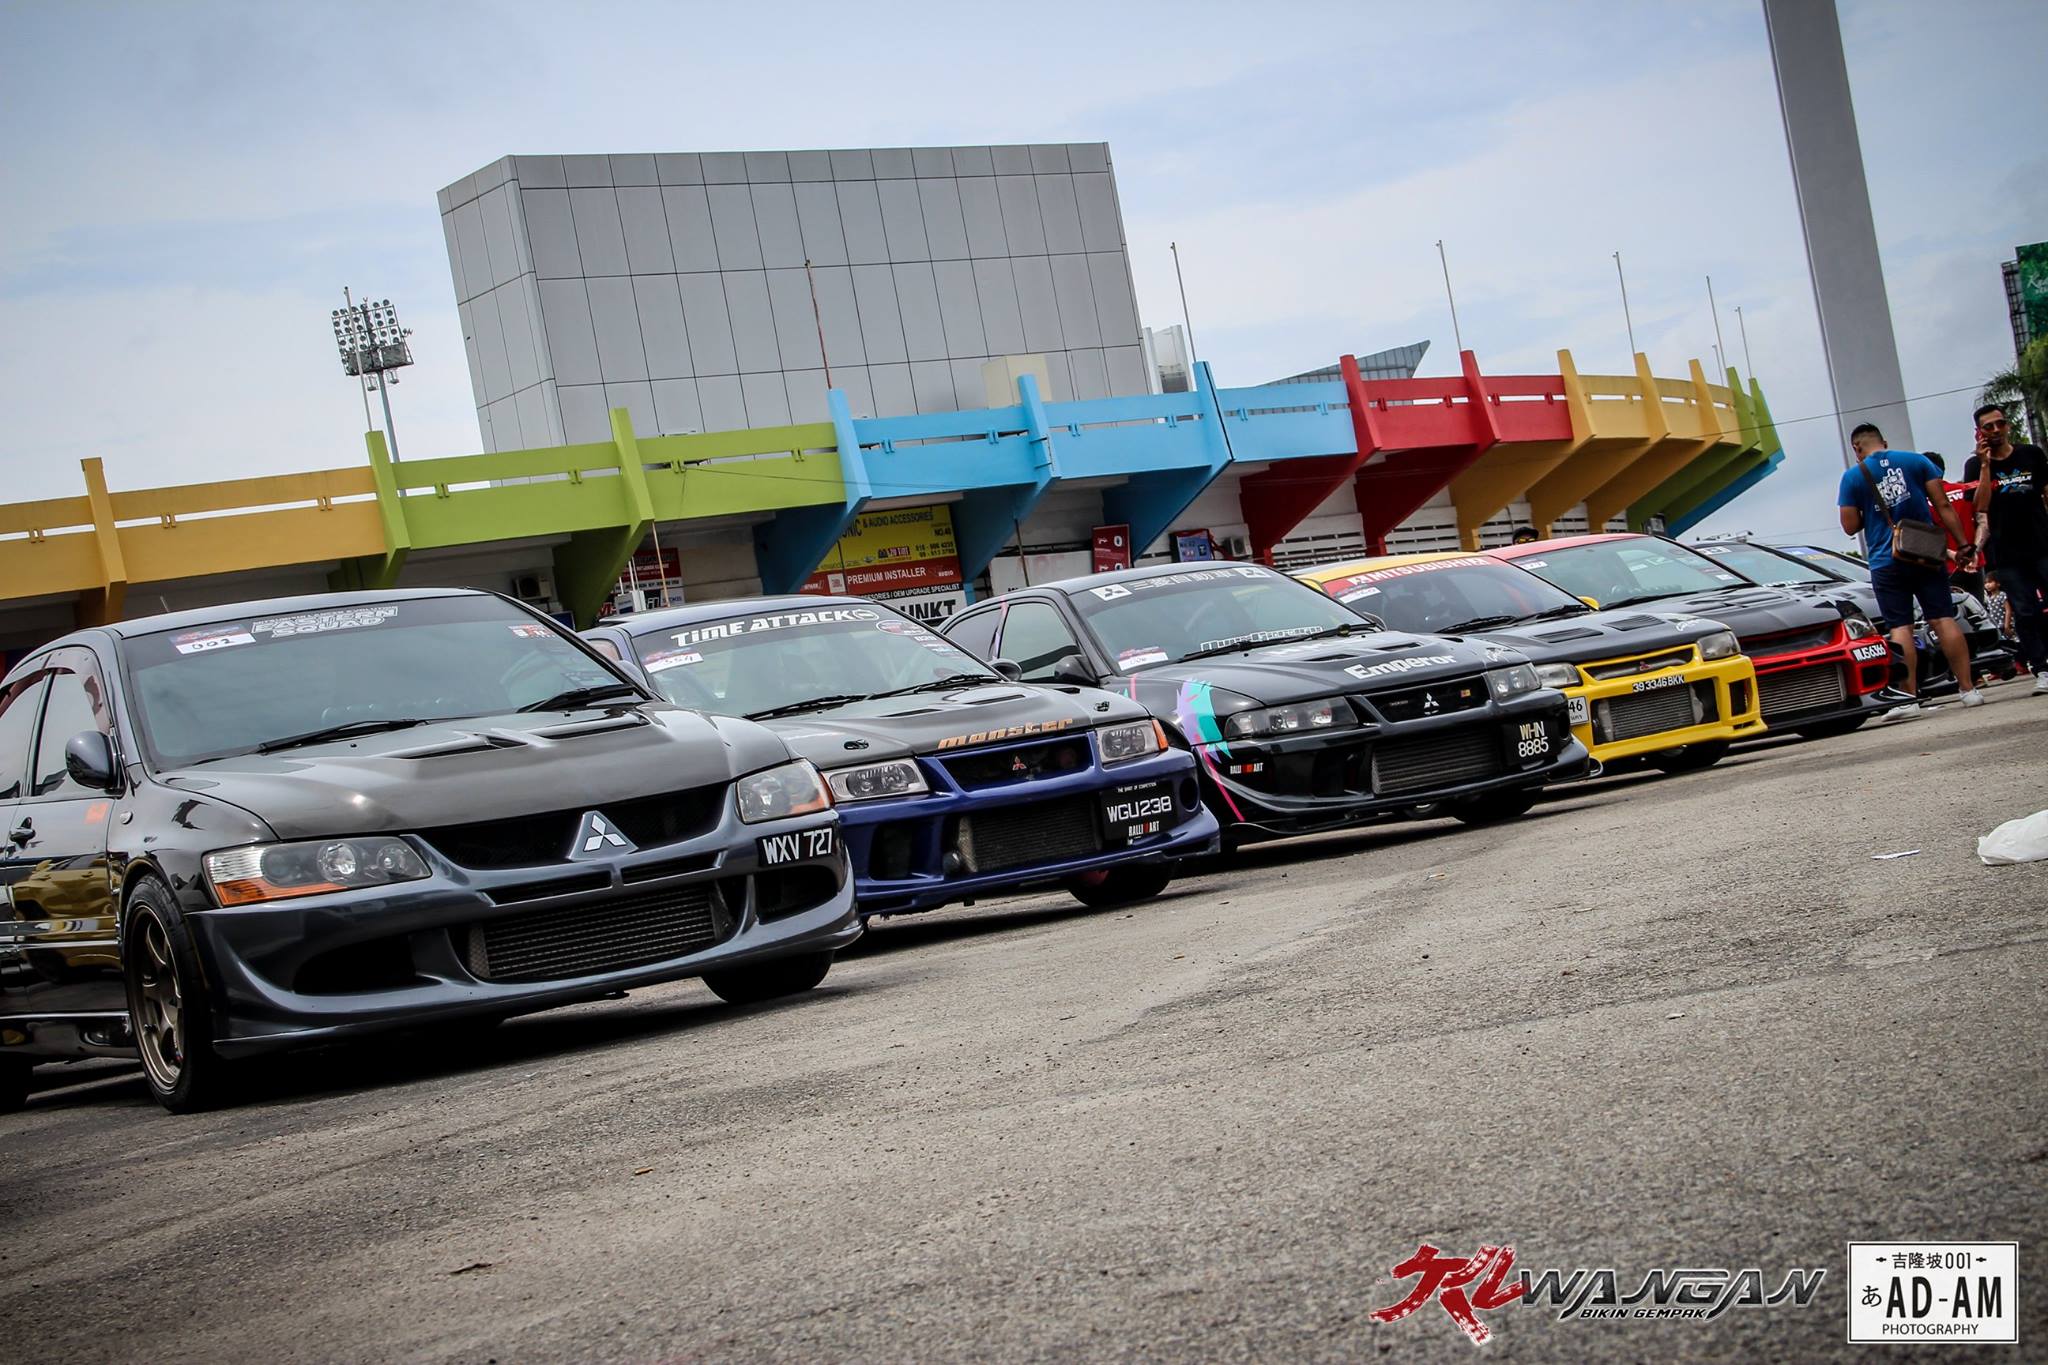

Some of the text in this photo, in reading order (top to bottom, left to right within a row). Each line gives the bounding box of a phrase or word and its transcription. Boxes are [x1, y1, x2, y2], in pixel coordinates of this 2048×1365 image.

[890, 511, 934, 526] ACCESSORIES
[847, 572, 884, 585] PREMIUM
[884, 567, 927, 580] INSTALLER
[1369, 559, 1466, 584] MITSUBISHI
[905, 586, 931, 597] UPGRADE
[931, 583, 960, 595] SPECIALIST
[251, 607, 398, 633] EASTERN
[271, 617, 386, 638] SQUAD
[670, 621, 744, 647] TIME
[1344, 653, 1456, 679] Emperor
[1519, 721, 1545, 741] WHN
[1518, 736, 1549, 757] 8885
[1106, 796, 1172, 823] WGU238
[762, 827, 832, 865] WXV 727
